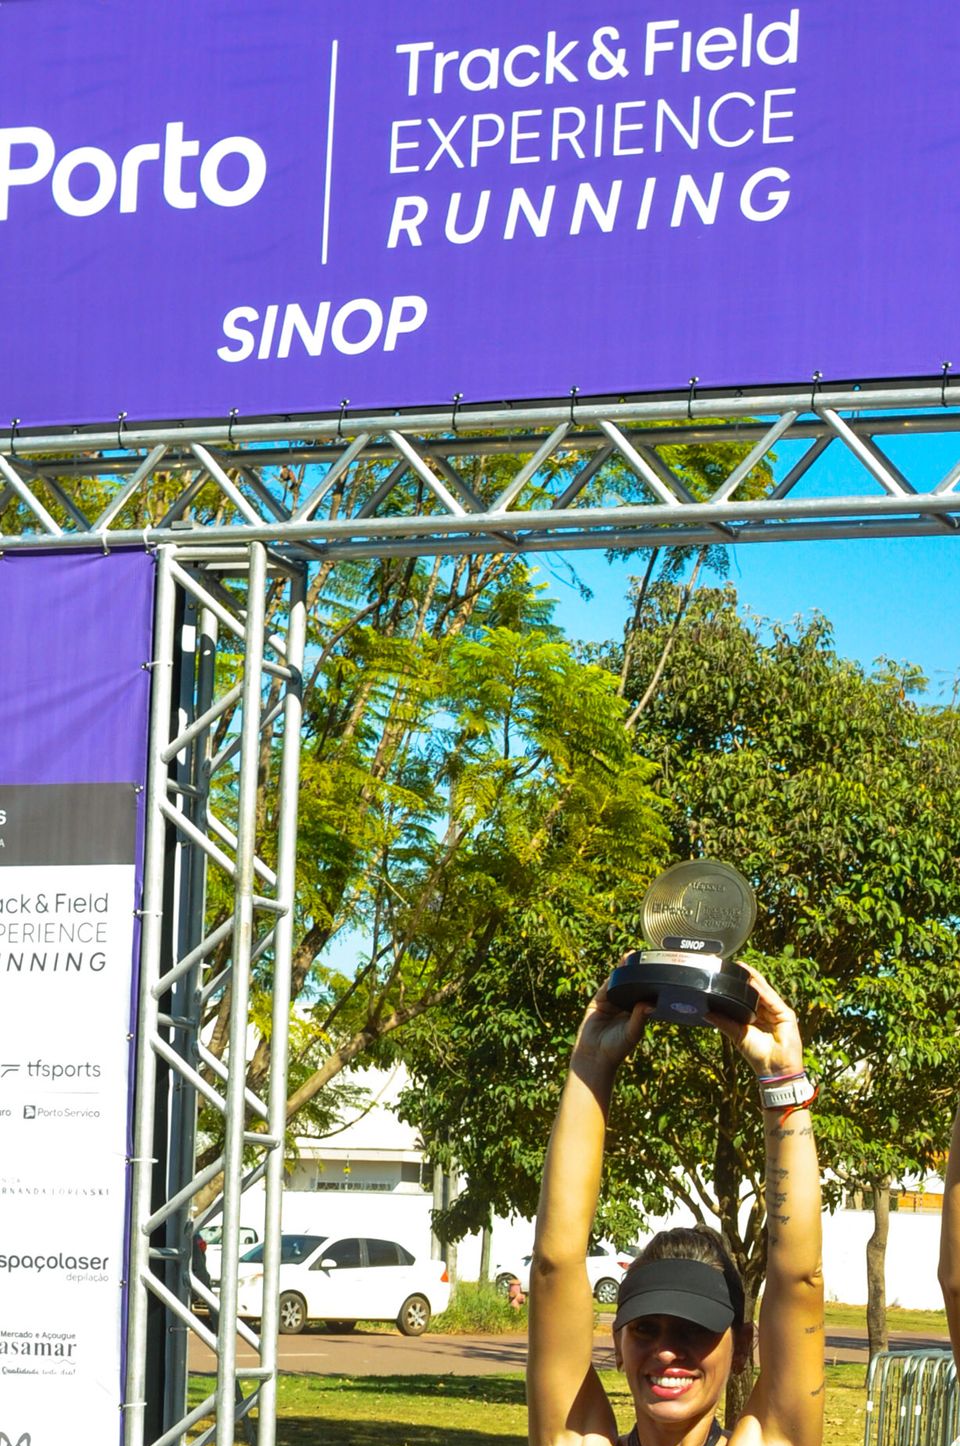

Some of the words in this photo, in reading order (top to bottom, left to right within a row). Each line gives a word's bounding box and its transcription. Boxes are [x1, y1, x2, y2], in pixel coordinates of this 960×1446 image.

[395, 30, 579, 97] Track
[587, 25, 630, 81] &
[644, 8, 800, 76] Field
[389, 87, 797, 174] EXPERIENCE
[0, 121, 267, 221] Porto
[386, 166, 791, 249] RUNNING
[216, 295, 428, 363] SINOP
[55, 892, 109, 914] Field
[679, 939, 705, 951] SINOP
[27, 1058, 102, 1081] tfsports
[0, 1252, 109, 1273] spaçolaser
[1, 1330, 33, 1339] Mercado
[42, 1332, 76, 1341] Açougue
